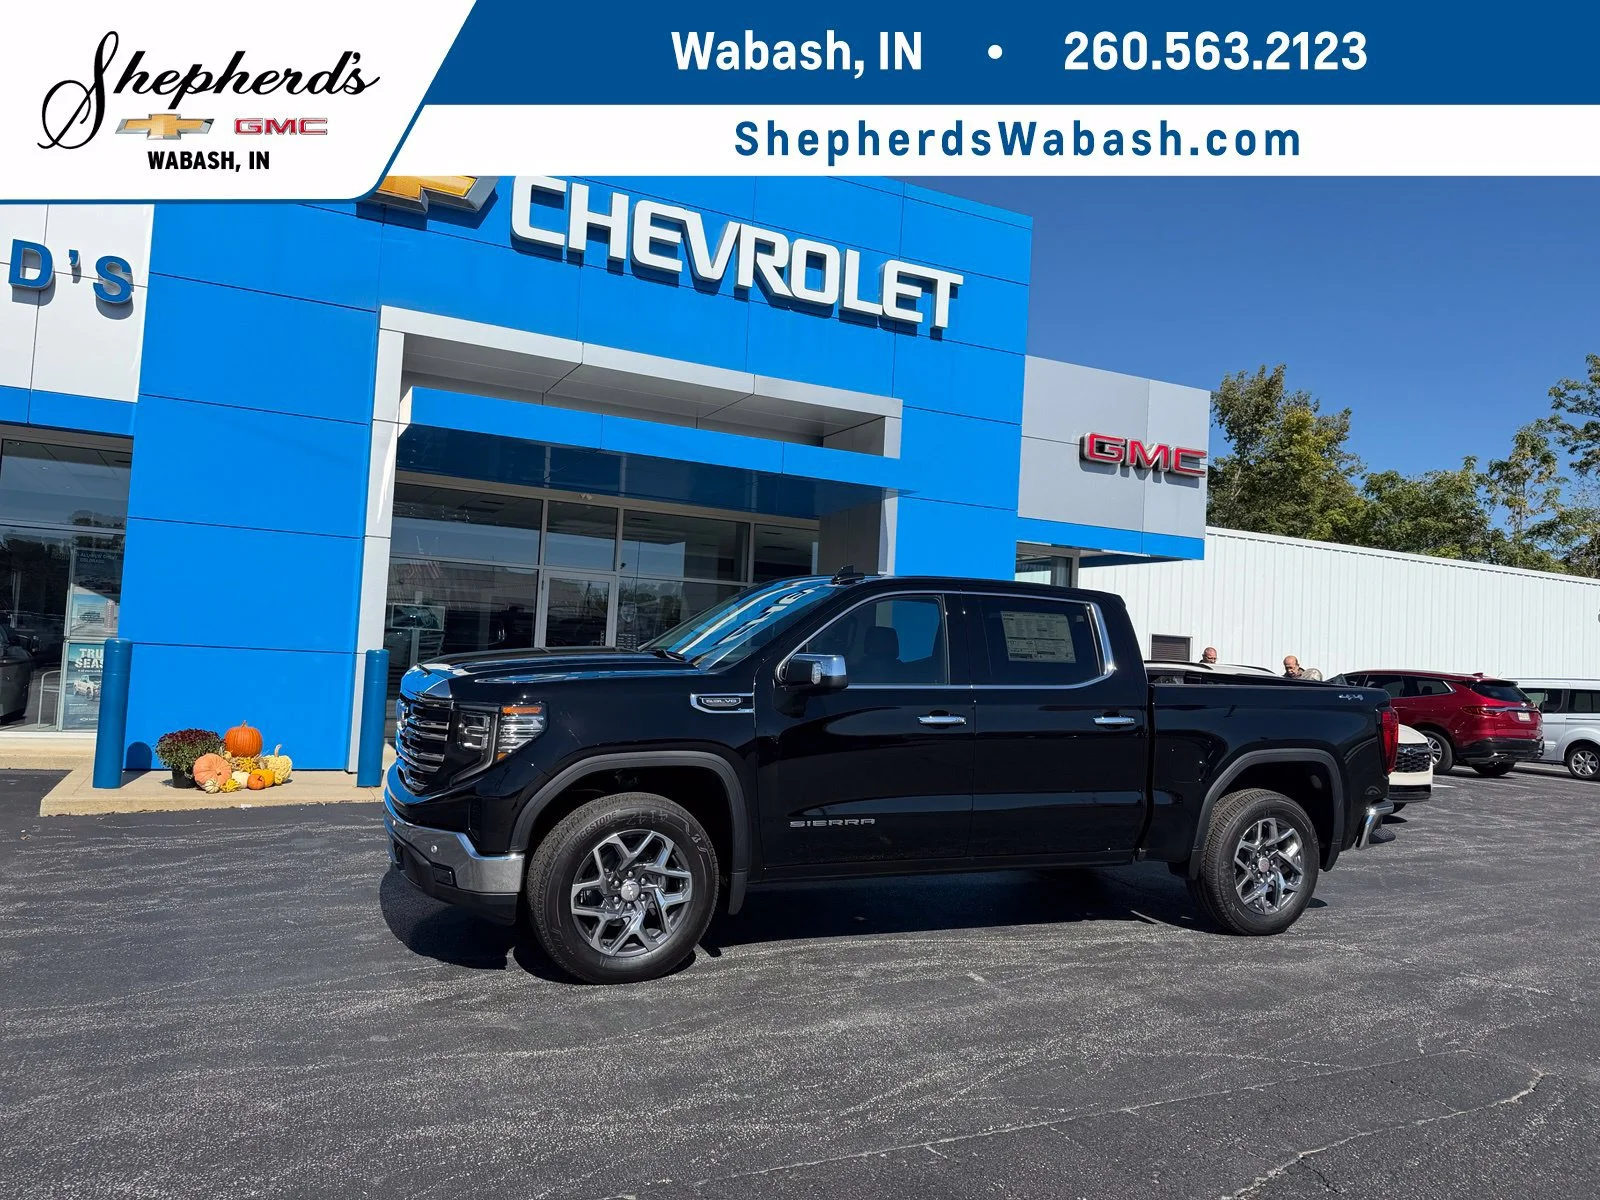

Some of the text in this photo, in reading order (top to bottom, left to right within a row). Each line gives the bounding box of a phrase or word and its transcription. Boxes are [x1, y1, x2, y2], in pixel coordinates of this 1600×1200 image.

[511, 176, 965, 330] CHEVROLET
[1083, 432, 1208, 478] GMC
[79, 648, 104, 659] TRU
[75, 658, 104, 669] SEAS
[789, 818, 876, 828] SIERRA
